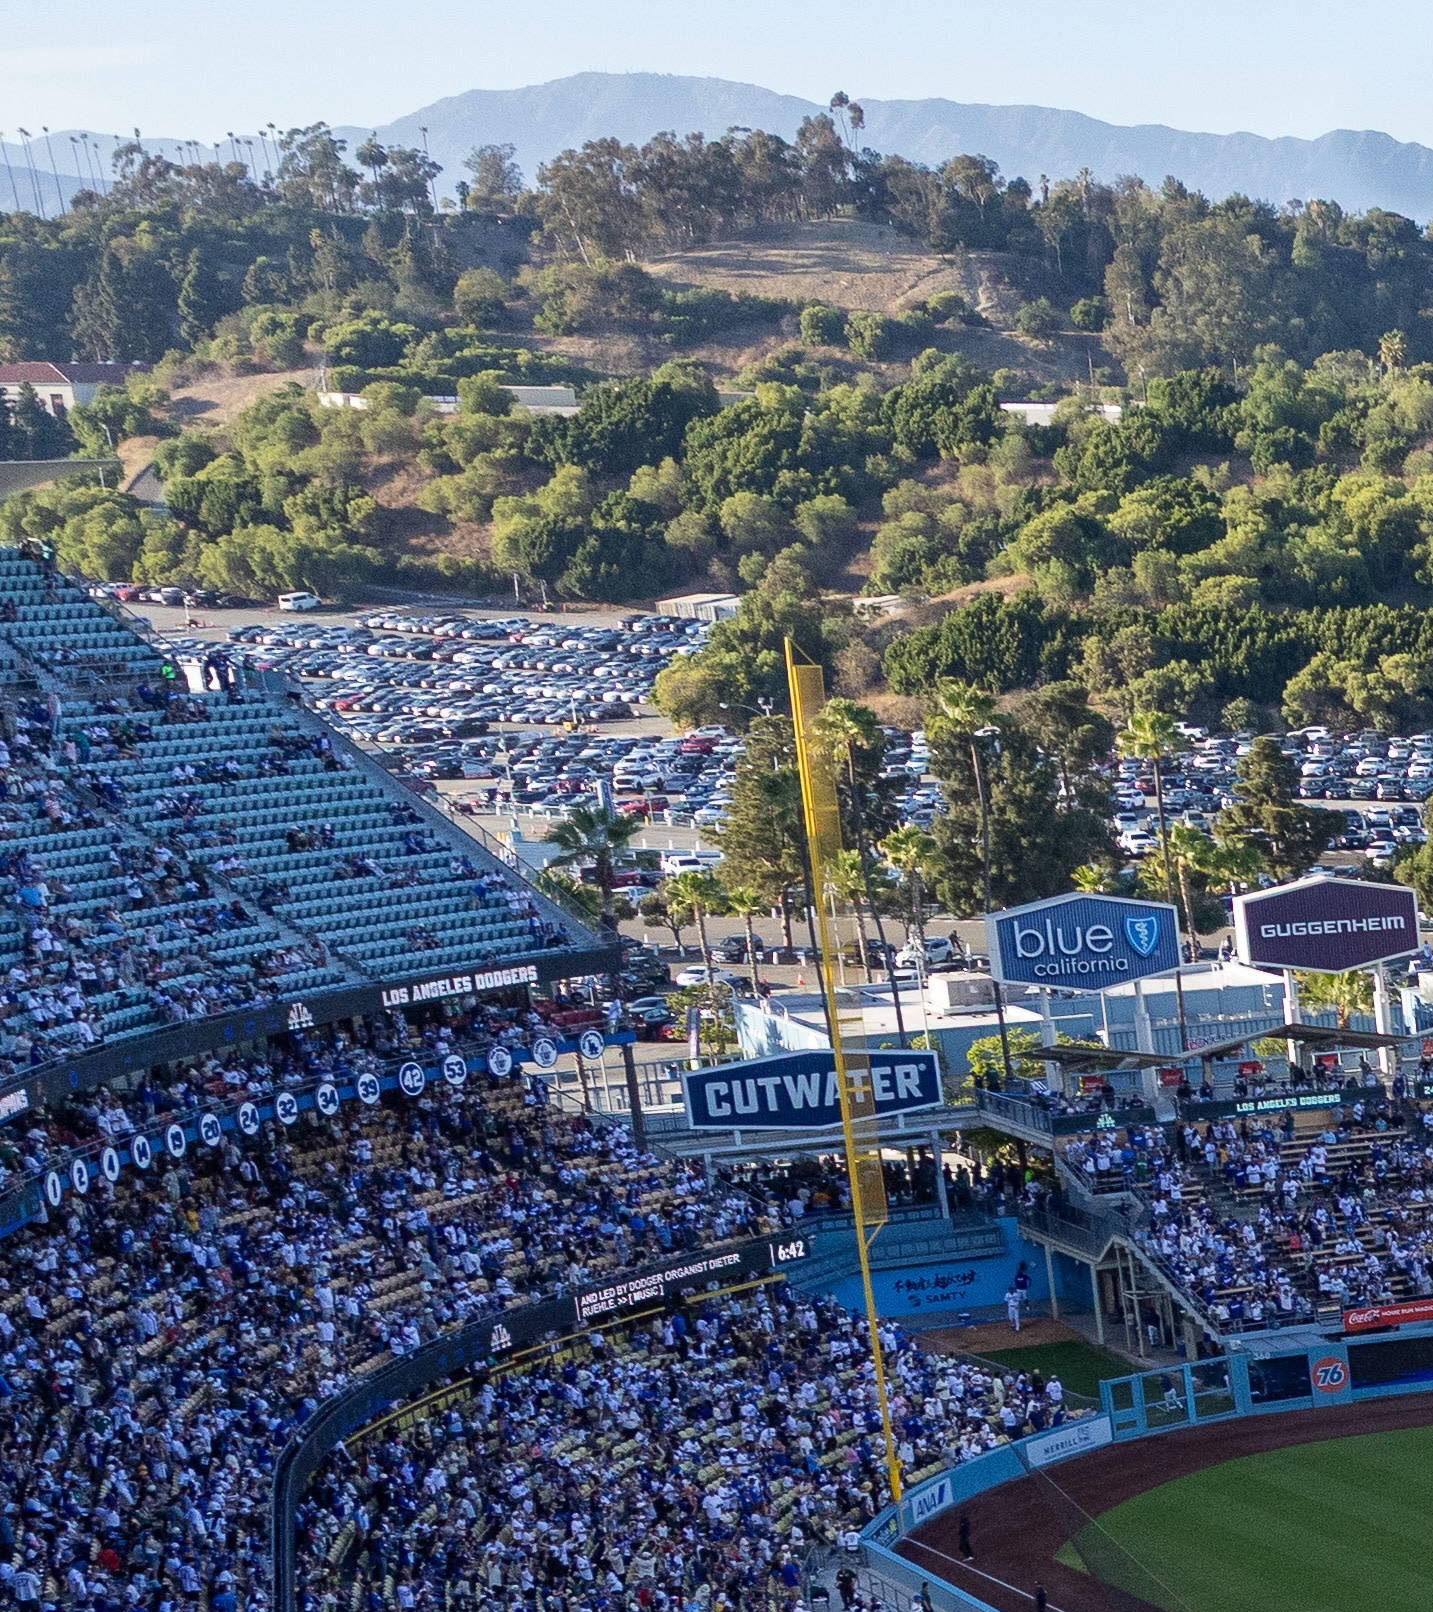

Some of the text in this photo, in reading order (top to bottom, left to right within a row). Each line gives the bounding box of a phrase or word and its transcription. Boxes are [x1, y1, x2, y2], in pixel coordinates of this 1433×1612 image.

[1261, 915, 1405, 939] GUGGENHEIM
[1014, 918, 1114, 959] blue
[1034, 956, 1129, 977] california
[382, 965, 538, 1007] LOS ANGELES DODGERS
[403, 1070, 422, 1088] 42
[446, 1062, 465, 1079] 53
[320, 1090, 339, 1107] 34
[359, 1081, 378, 1098] 39
[704, 1063, 924, 1118] CUTWATER
[280, 1099, 297, 1117] 32
[203, 1120, 221, 1140] 20
[241, 1110, 259, 1130] 24
[170, 1130, 185, 1150] 19
[76, 1166, 87, 1186] 2
[777, 1241, 805, 1261] 6:42
[581, 1254, 740, 1307] AND LED BY DODGER ORGANIST DIETER
[1315, 1364, 1345, 1386] 76
